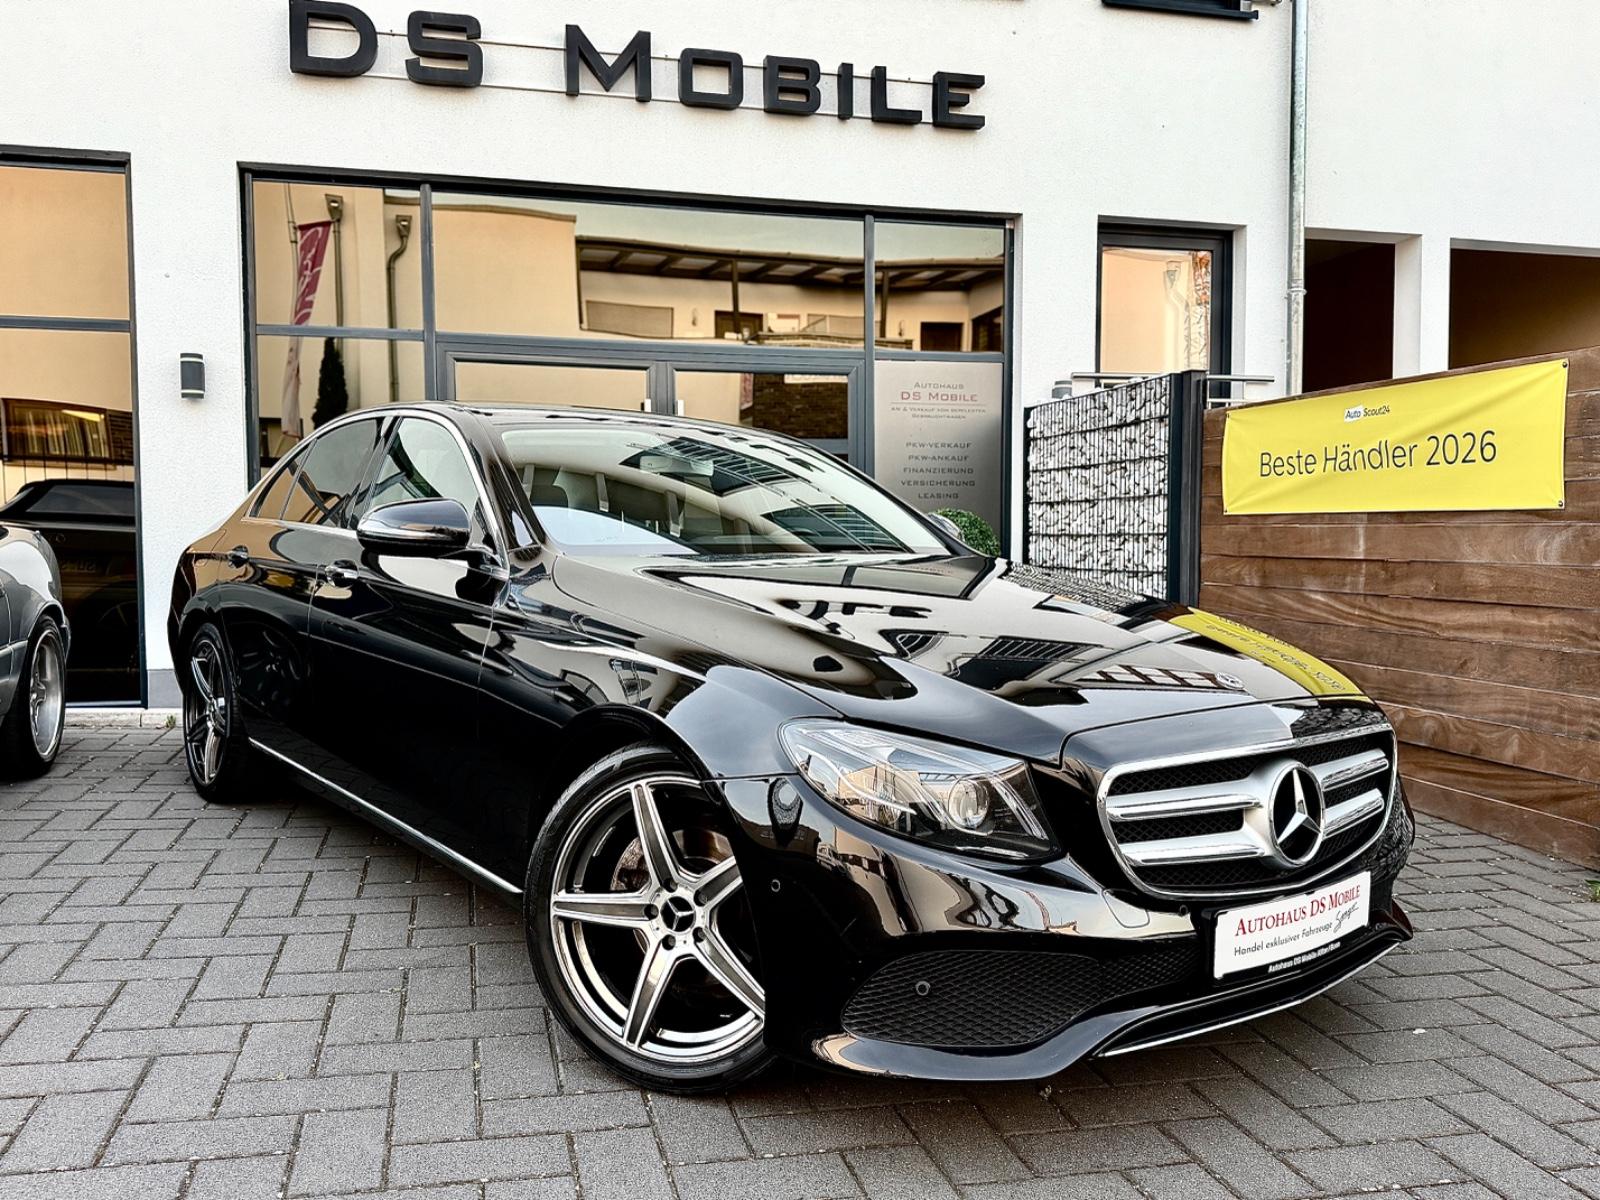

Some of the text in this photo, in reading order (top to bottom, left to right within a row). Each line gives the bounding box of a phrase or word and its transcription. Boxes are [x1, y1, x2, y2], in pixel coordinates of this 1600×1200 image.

[289, 0, 985, 130] DS MOBILE
[901, 391, 978, 402] DS MOBILE
[914, 382, 964, 390] AUTOHAUS
[1345, 410, 1361, 419] Auto
[1260, 430, 1497, 477] Beste Händler 2026
[1235, 885, 1360, 936] AUTOHAUS DS MOBILE
[1234, 922, 1332, 956] Handel exklusiver Fahrzeuge
